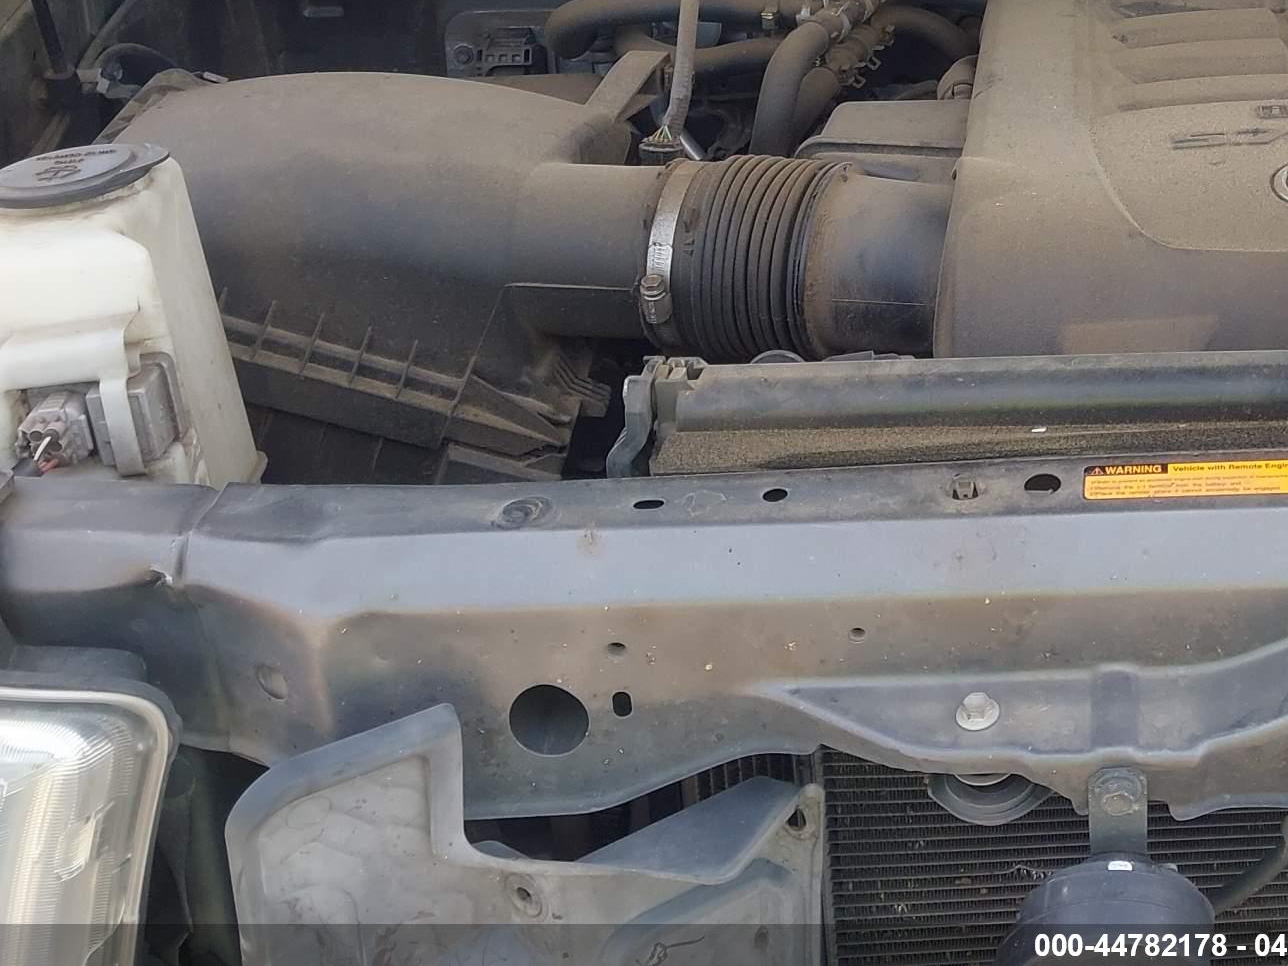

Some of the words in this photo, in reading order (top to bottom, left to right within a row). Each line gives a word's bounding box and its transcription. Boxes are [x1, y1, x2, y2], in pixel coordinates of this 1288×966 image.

[1104, 464, 1162, 475] WARNING
[1172, 465, 1204, 473] Vehicle
[1228, 463, 1263, 471] Remote
